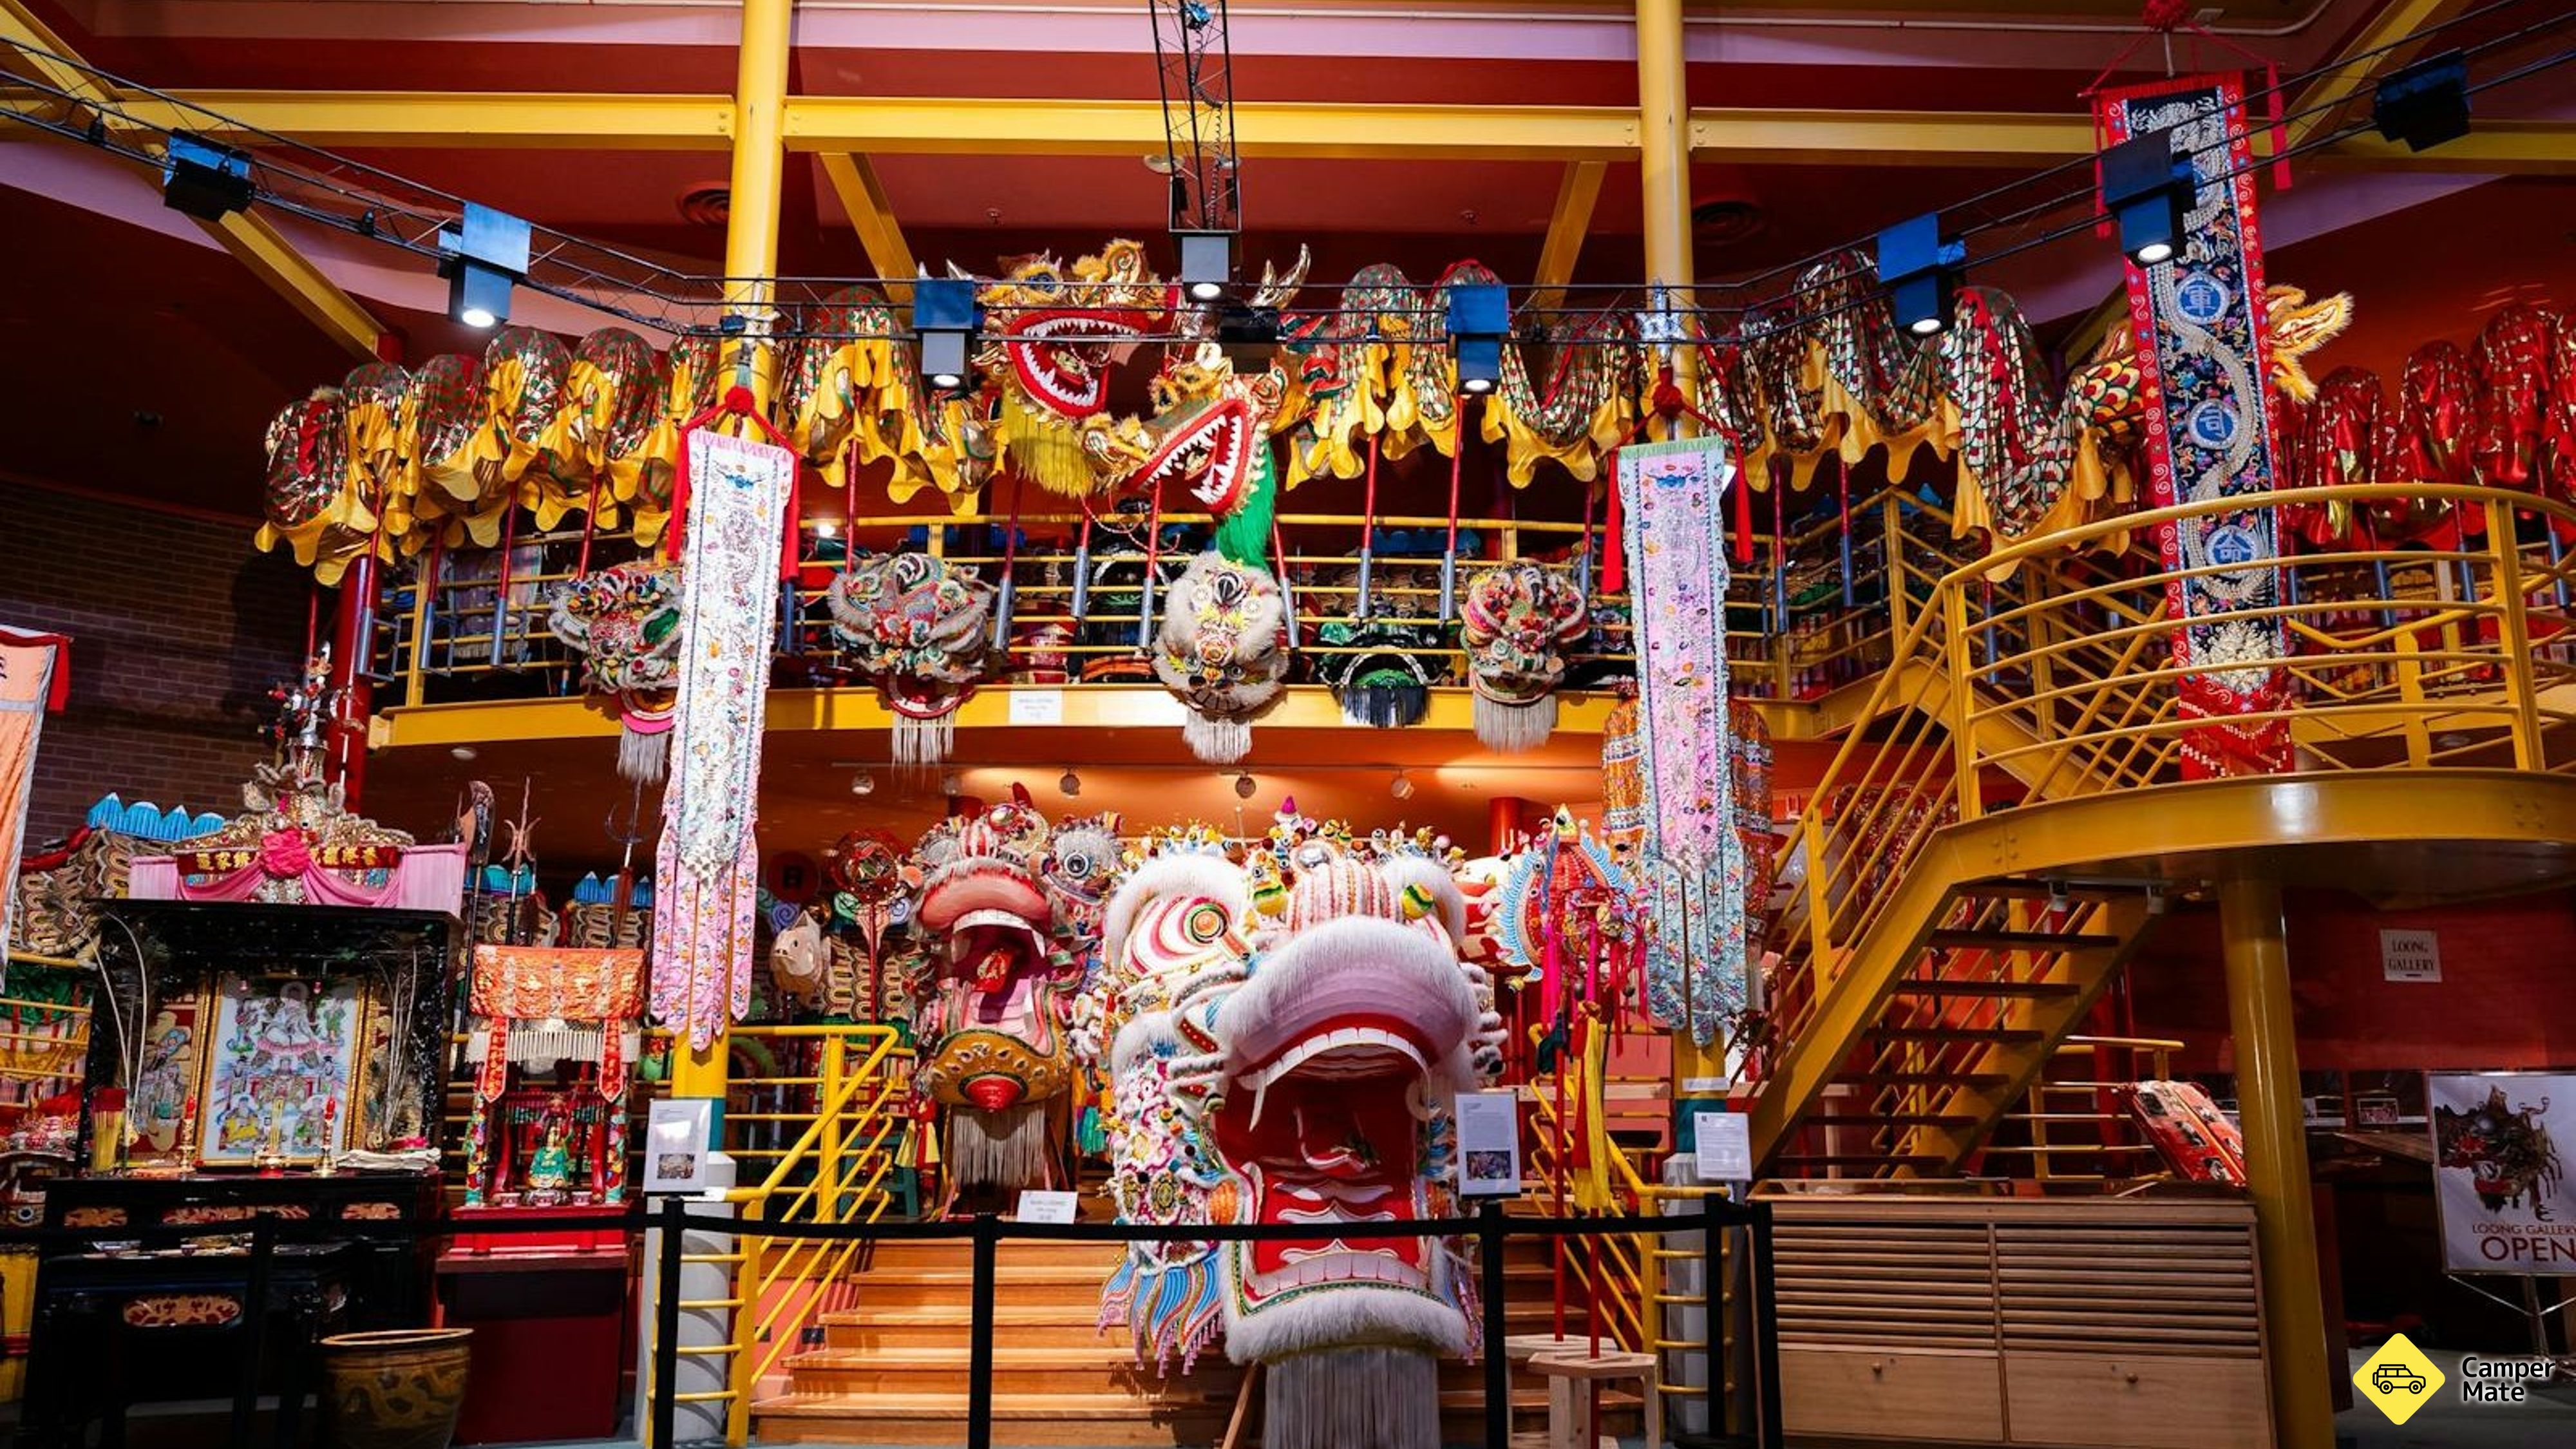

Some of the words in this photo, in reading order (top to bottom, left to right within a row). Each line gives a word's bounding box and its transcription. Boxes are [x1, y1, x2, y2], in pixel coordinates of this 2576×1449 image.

[2392, 940, 2428, 953] LOONG
[2388, 958, 2434, 971] GALLERY
[2472, 1224, 2522, 1235] LOONG
[2481, 1236, 2576, 1262] OPEN
